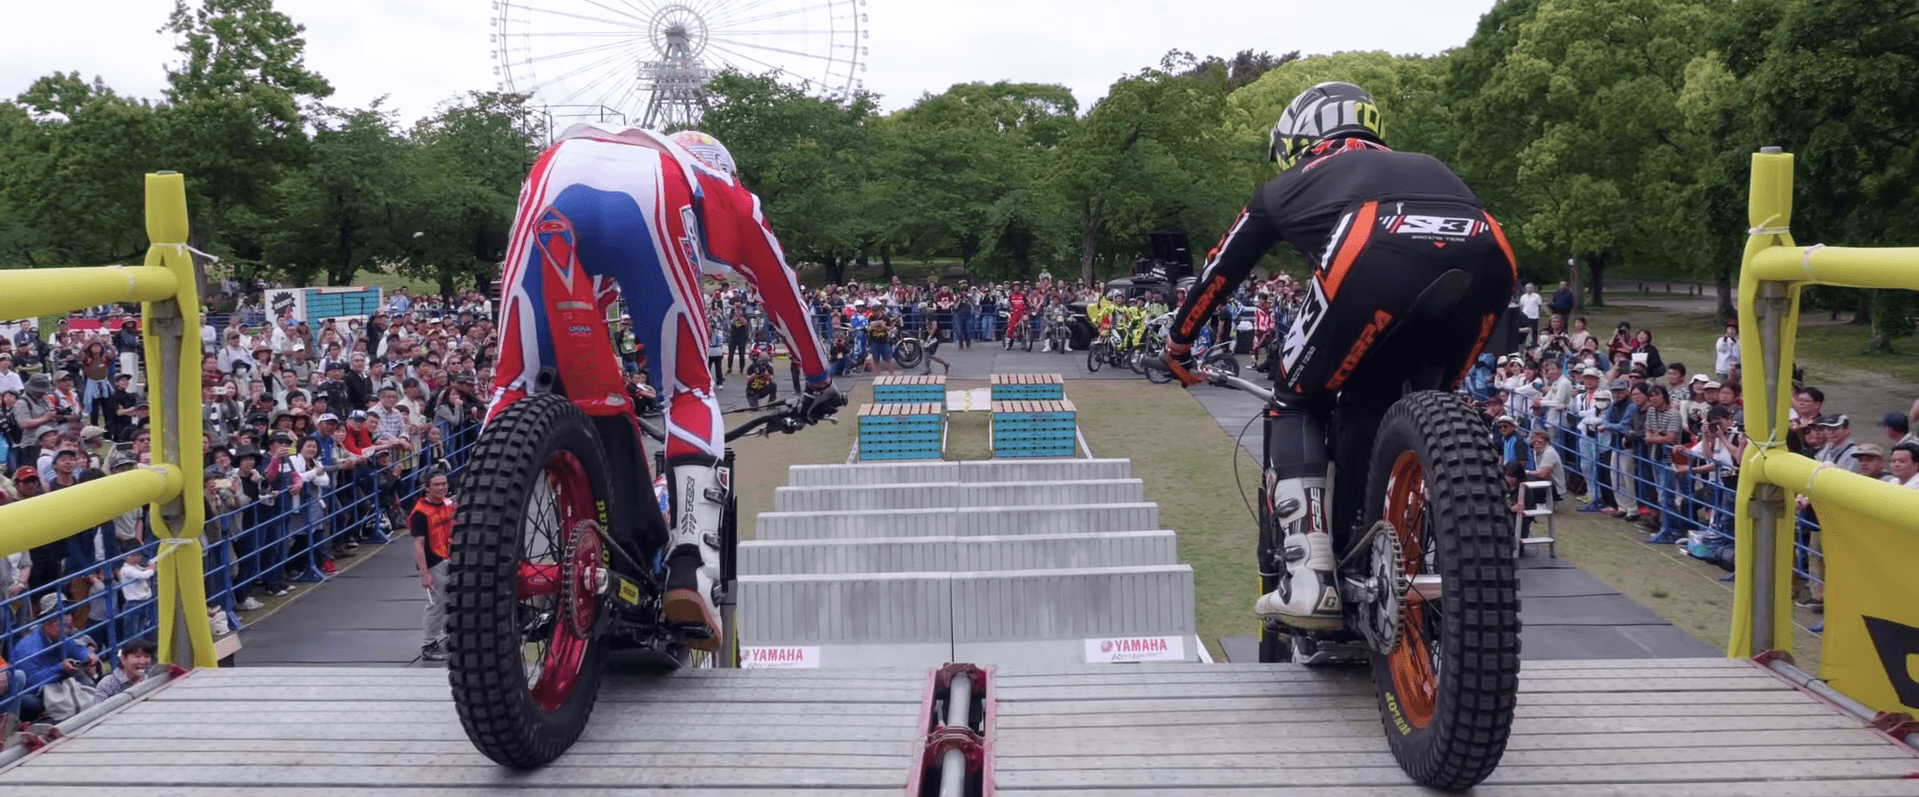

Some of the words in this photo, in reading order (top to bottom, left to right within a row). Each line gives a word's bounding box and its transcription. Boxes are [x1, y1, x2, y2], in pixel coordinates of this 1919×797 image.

[1181, 274, 1226, 335] SCORPA
[1325, 309, 1393, 389] SCORPA
[752, 648, 804, 661] YAMAHA
[1114, 638, 1167, 652] YAMAHA
[1385, 692, 1411, 735] DUNLOP
